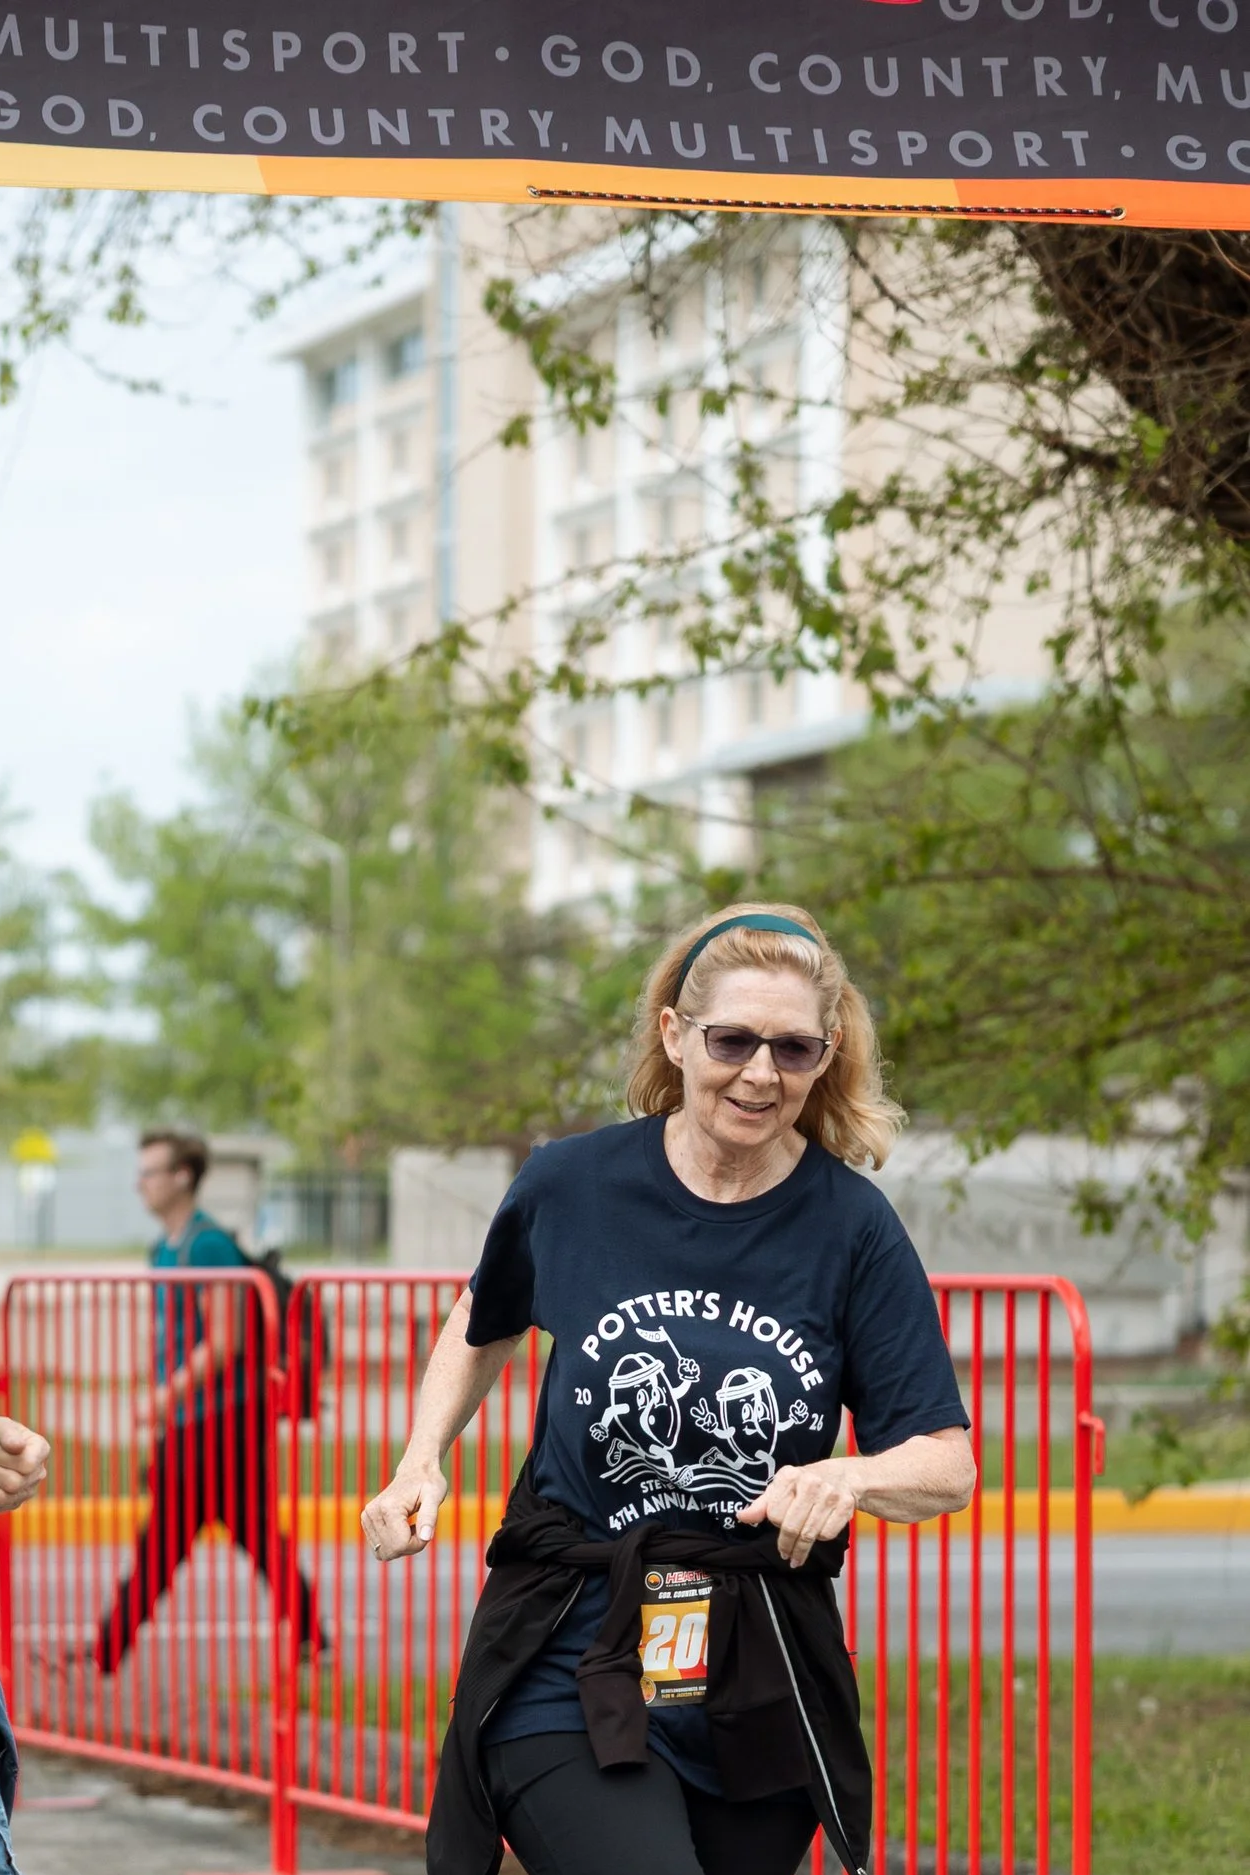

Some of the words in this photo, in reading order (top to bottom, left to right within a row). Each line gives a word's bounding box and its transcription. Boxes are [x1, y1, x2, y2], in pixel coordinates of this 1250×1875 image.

[541, 34, 714, 93] GOD,
[748, 52, 1121, 102] COUNTRY,
[192, 103, 569, 153] COUNTRY,
[604, 115, 1090, 168] MULTISPORT
[581, 1289, 721, 1362] POTTER'S
[728, 1300, 824, 1392] HOUSE
[574, 1387, 593, 1406] 20
[608, 1503, 640, 1532] 4TH
[643, 1612, 708, 1671] 20
